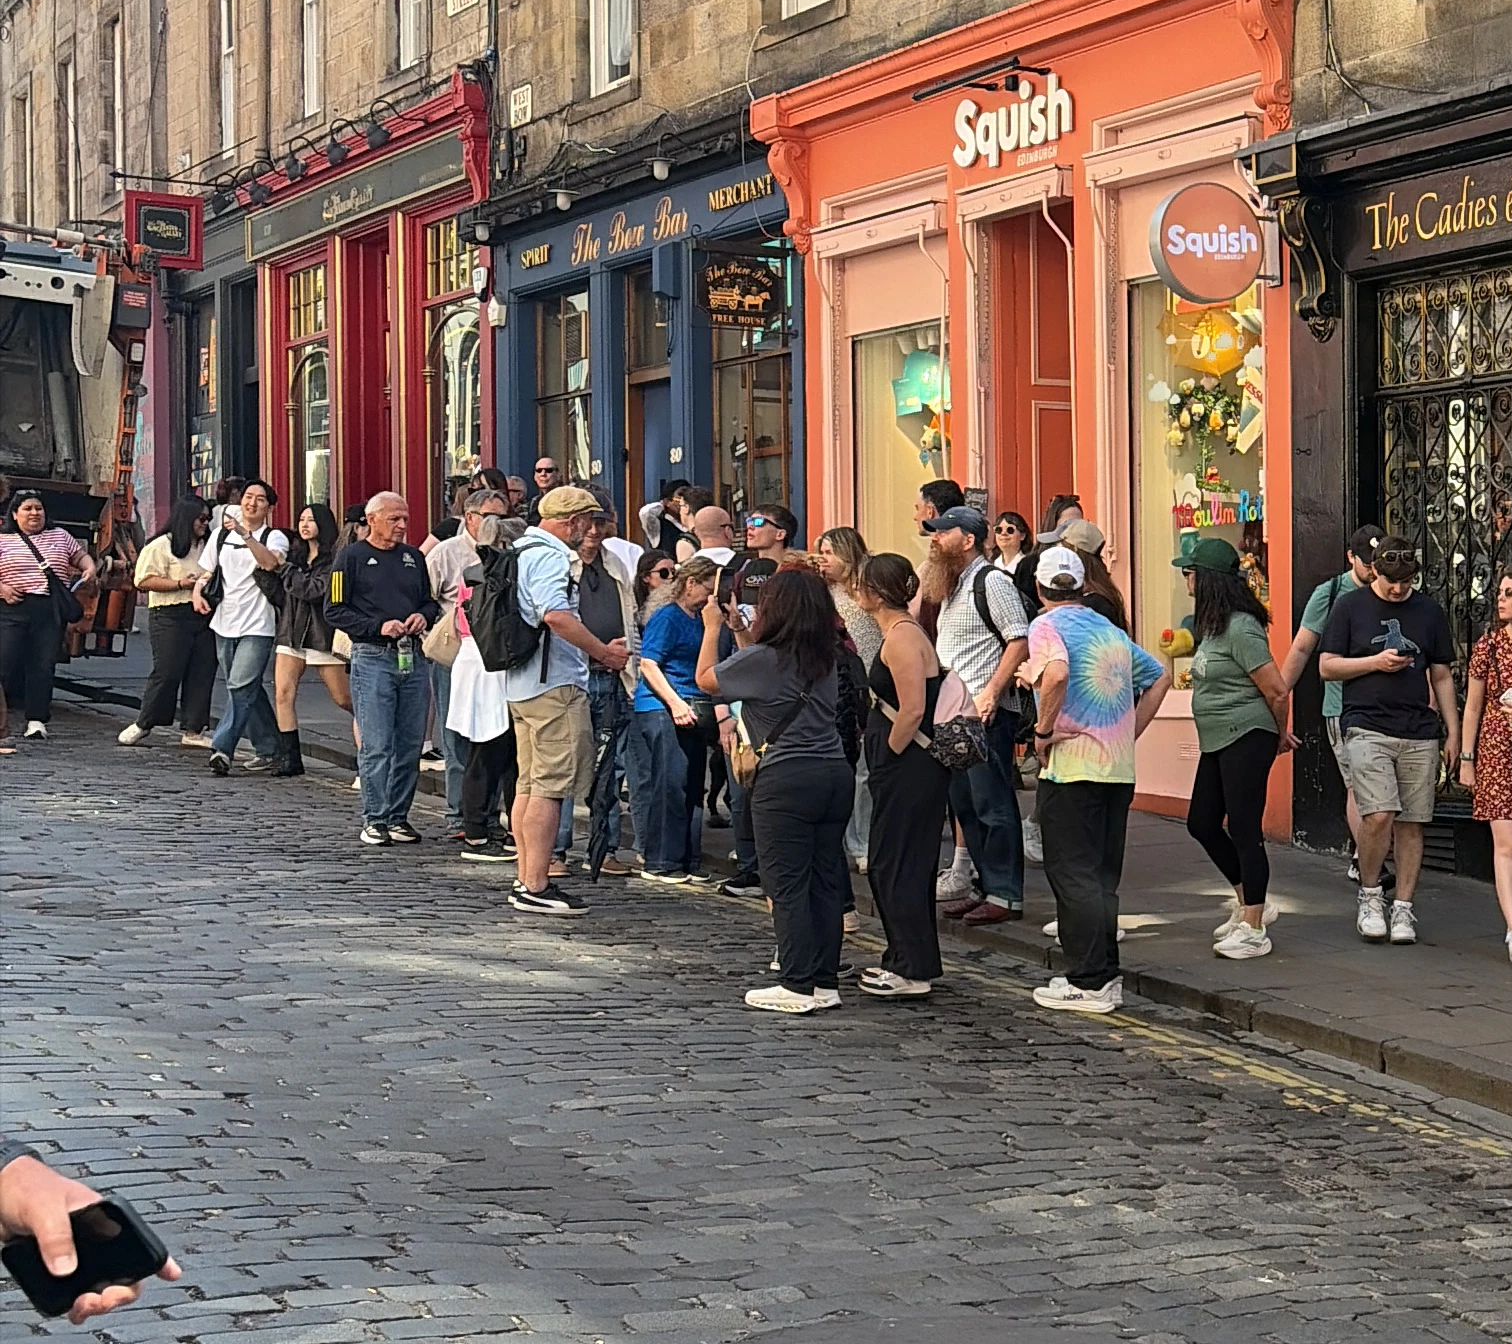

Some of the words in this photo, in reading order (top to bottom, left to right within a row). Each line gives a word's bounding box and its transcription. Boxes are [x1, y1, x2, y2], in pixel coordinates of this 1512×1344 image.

[513, 88, 530, 106] WEST
[513, 107, 528, 125] BOW
[953, 73, 1072, 167] Squish
[1016, 145, 1058, 167] EDINBURGH
[520, 243, 550, 270] SPIRIT
[570, 222, 601, 267] The
[607, 210, 645, 255] Bow
[653, 196, 688, 241] Bar
[707, 173, 774, 212] MERCHANT
[1365, 191, 1409, 252] The
[1415, 175, 1497, 241] Cadies
[1167, 223, 1257, 258] Squish
[706, 265, 725, 283] The
[712, 314, 734, 323] FREE
[737, 315, 766, 325] HOUSE
[670, 447, 683, 464] 80
[591, 459, 602, 475] 80
[1173, 494, 1236, 529] Moulin
